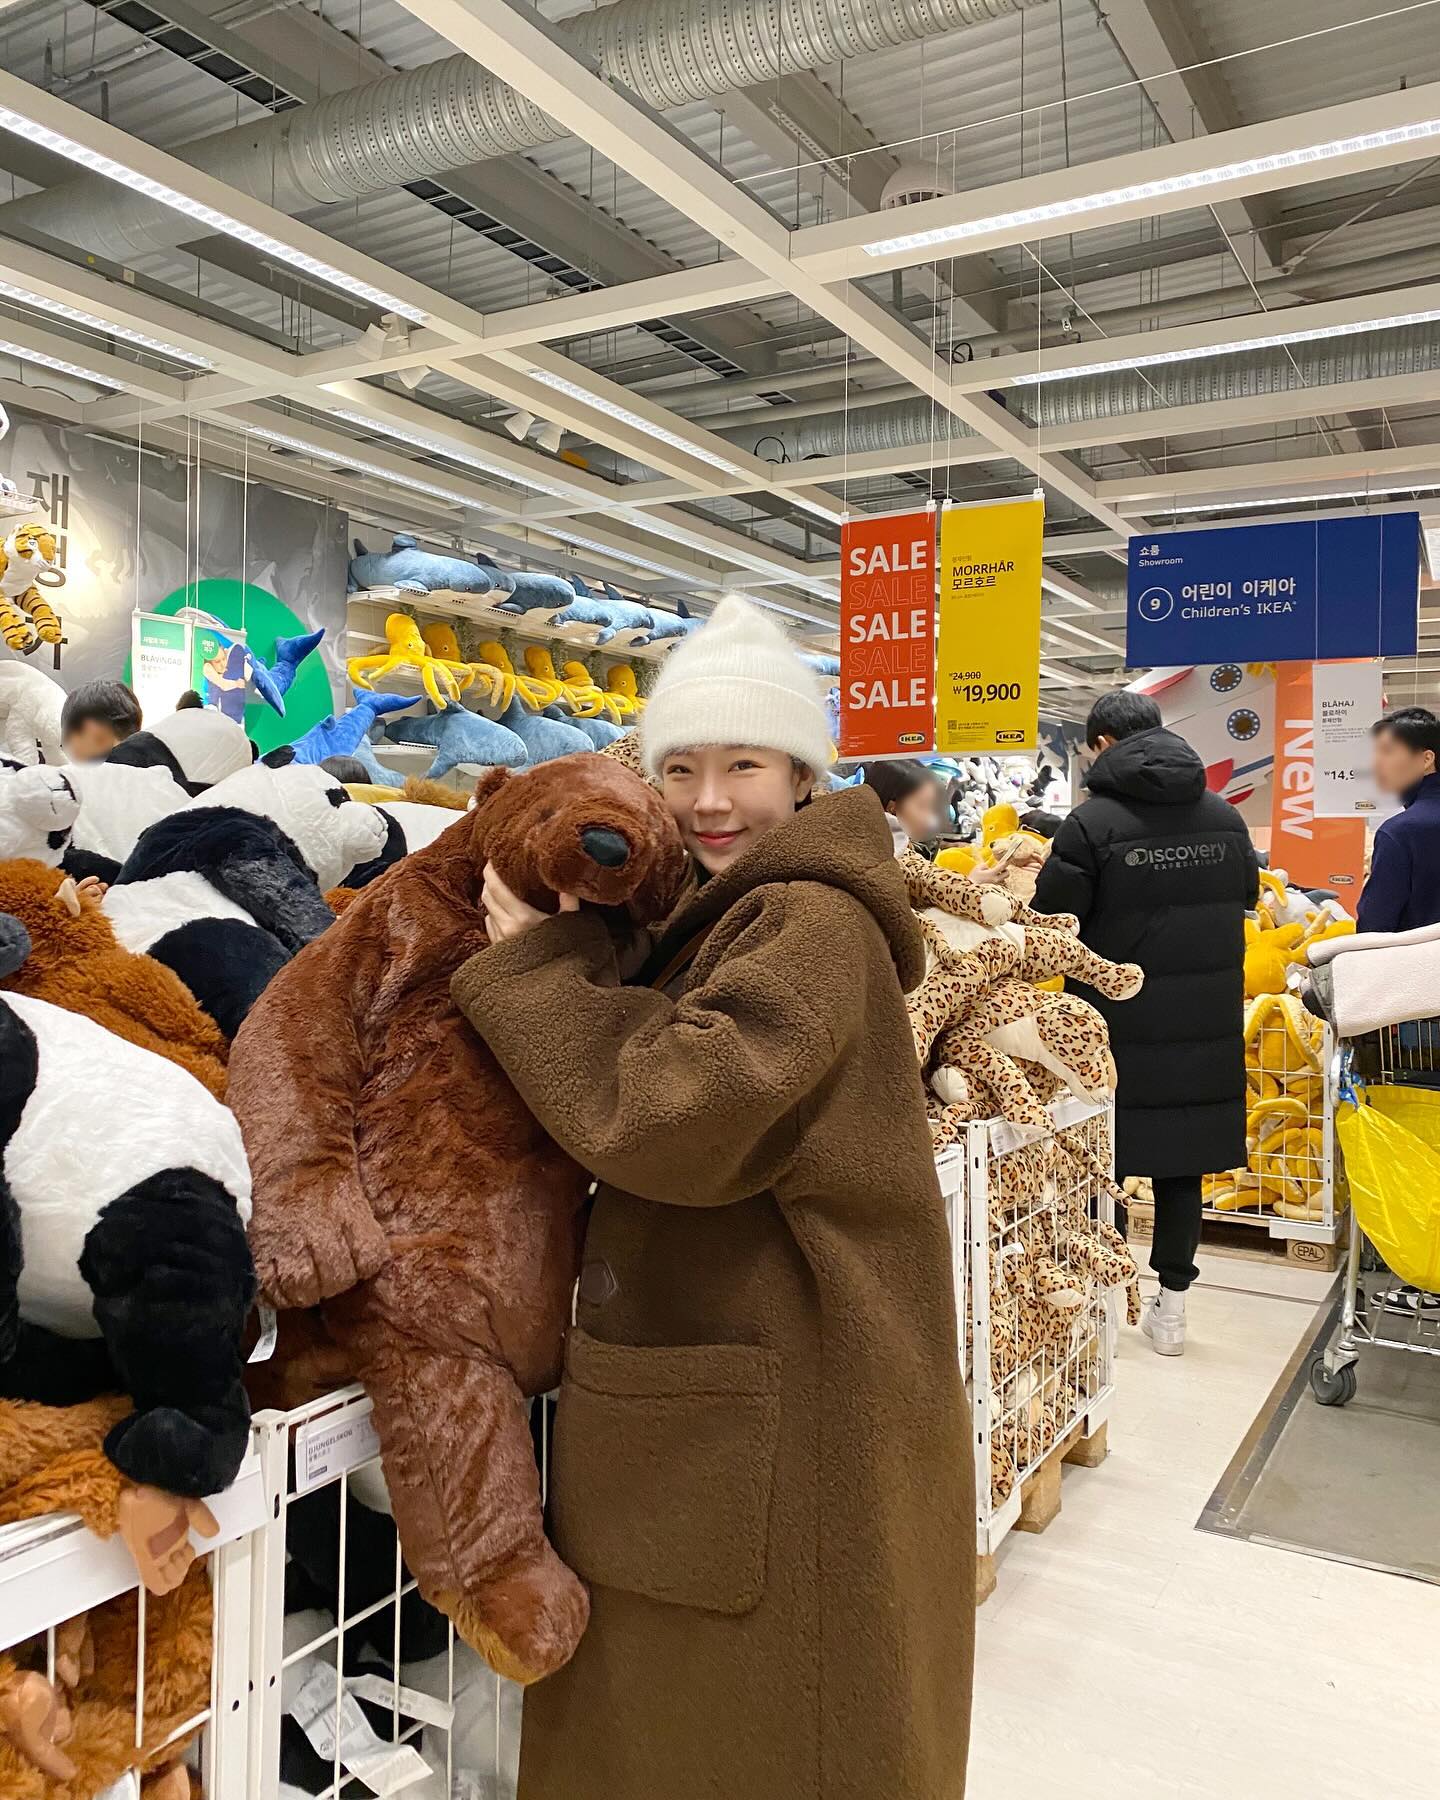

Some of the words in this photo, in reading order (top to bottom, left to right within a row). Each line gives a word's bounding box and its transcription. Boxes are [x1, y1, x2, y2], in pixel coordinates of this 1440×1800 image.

[850, 540, 928, 577] SALE
[1139, 544, 1160, 556] 쇼룸
[952, 560, 1015, 577] MORRHÅR
[1138, 557, 1184, 567] Showroom
[849, 574, 928, 611] SALE
[952, 575, 997, 590] 모르호르
[1181, 581, 1232, 602] 어린이
[1242, 577, 1297, 598] 이케아
[1150, 598, 1161, 611] 9
[1181, 603, 1251, 619] Children's
[849, 609, 927, 644] SALE
[849, 642, 927, 678] SALE
[849, 677, 926, 710] SALE
[1280, 719, 1315, 840] New
[1297, 1245, 1322, 1259] EPAL
